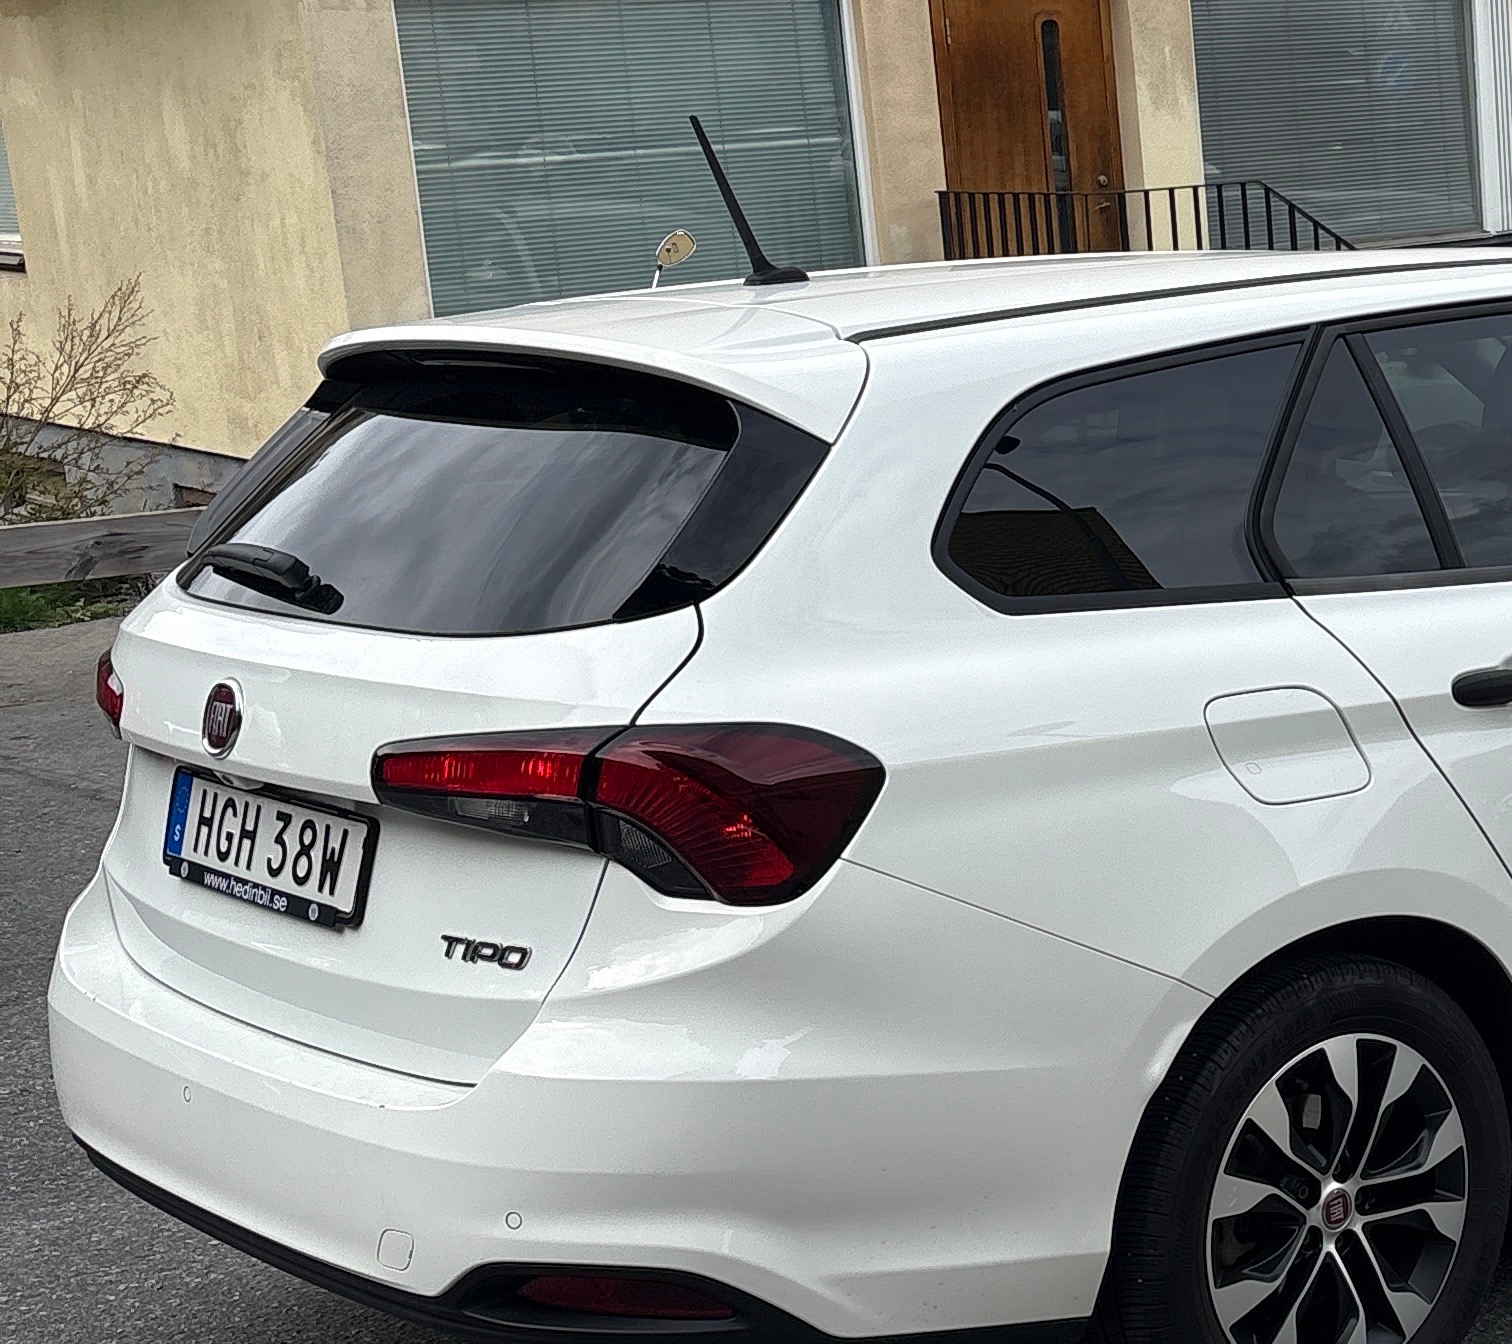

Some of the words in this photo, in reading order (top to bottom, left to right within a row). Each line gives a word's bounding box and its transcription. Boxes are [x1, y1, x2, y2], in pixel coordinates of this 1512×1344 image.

[209, 701, 234, 738] FIAT
[173, 823, 182, 842] S
[193, 788, 262, 872] HGH
[266, 809, 350, 897] 38W
[203, 870, 288, 912] www.hedinbil.se
[440, 934, 533, 971] TIPO
[1329, 1197, 1345, 1222] FIAT
